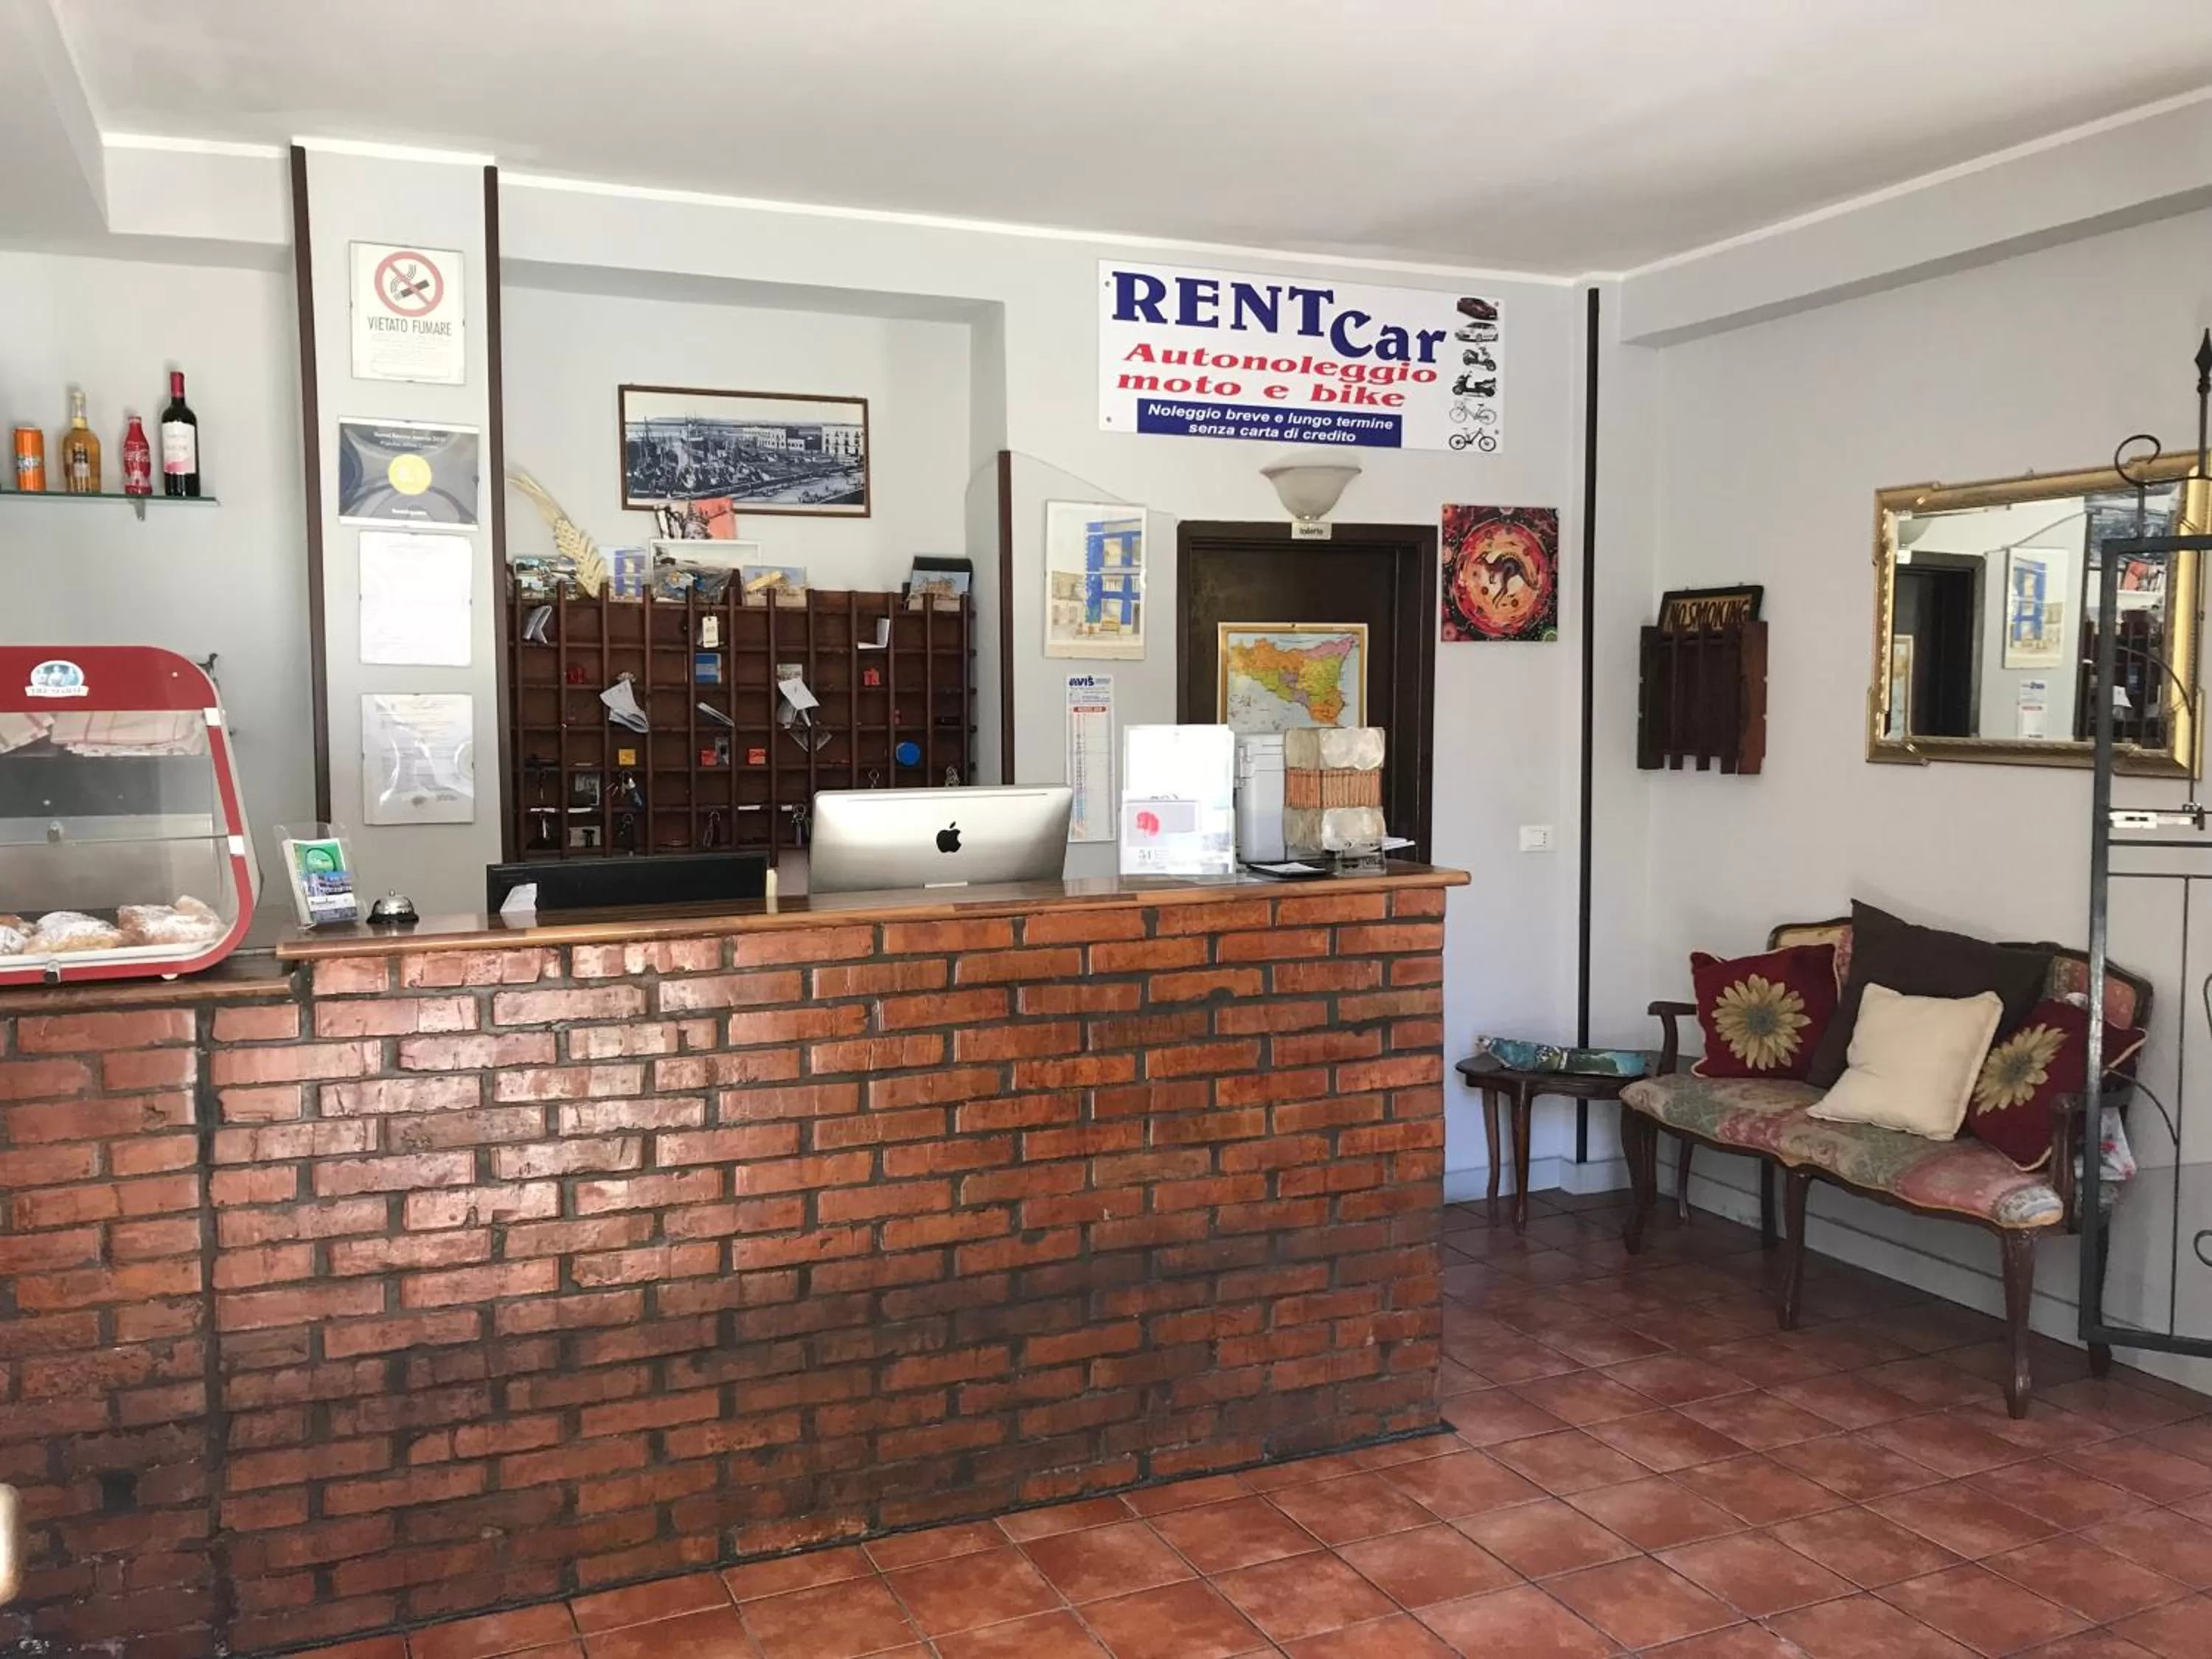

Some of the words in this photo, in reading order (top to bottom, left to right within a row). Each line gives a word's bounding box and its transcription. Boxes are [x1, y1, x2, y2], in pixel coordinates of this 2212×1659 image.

[367, 316, 408, 333] VIETATO
[412, 319, 452, 337] FUMARE
[1112, 271, 1334, 337] RENT
[1329, 310, 1447, 364] Car
[1124, 343, 1438, 386] Autonoleggio
[1117, 374, 1242, 397] moto
[1264, 385, 1290, 400] e
[1310, 383, 1406, 408] bike
[1147, 403, 1221, 421] Noleggio
[1225, 408, 1270, 423] breve
[1274, 414, 1284, 424] e
[1287, 412, 1332, 428] lungo
[1336, 415, 1394, 431] termine
[1188, 423, 1235, 436] senza
[1239, 425, 1279, 438] carta
[1284, 427, 1299, 439] di
[1303, 430, 1357, 442] credito
